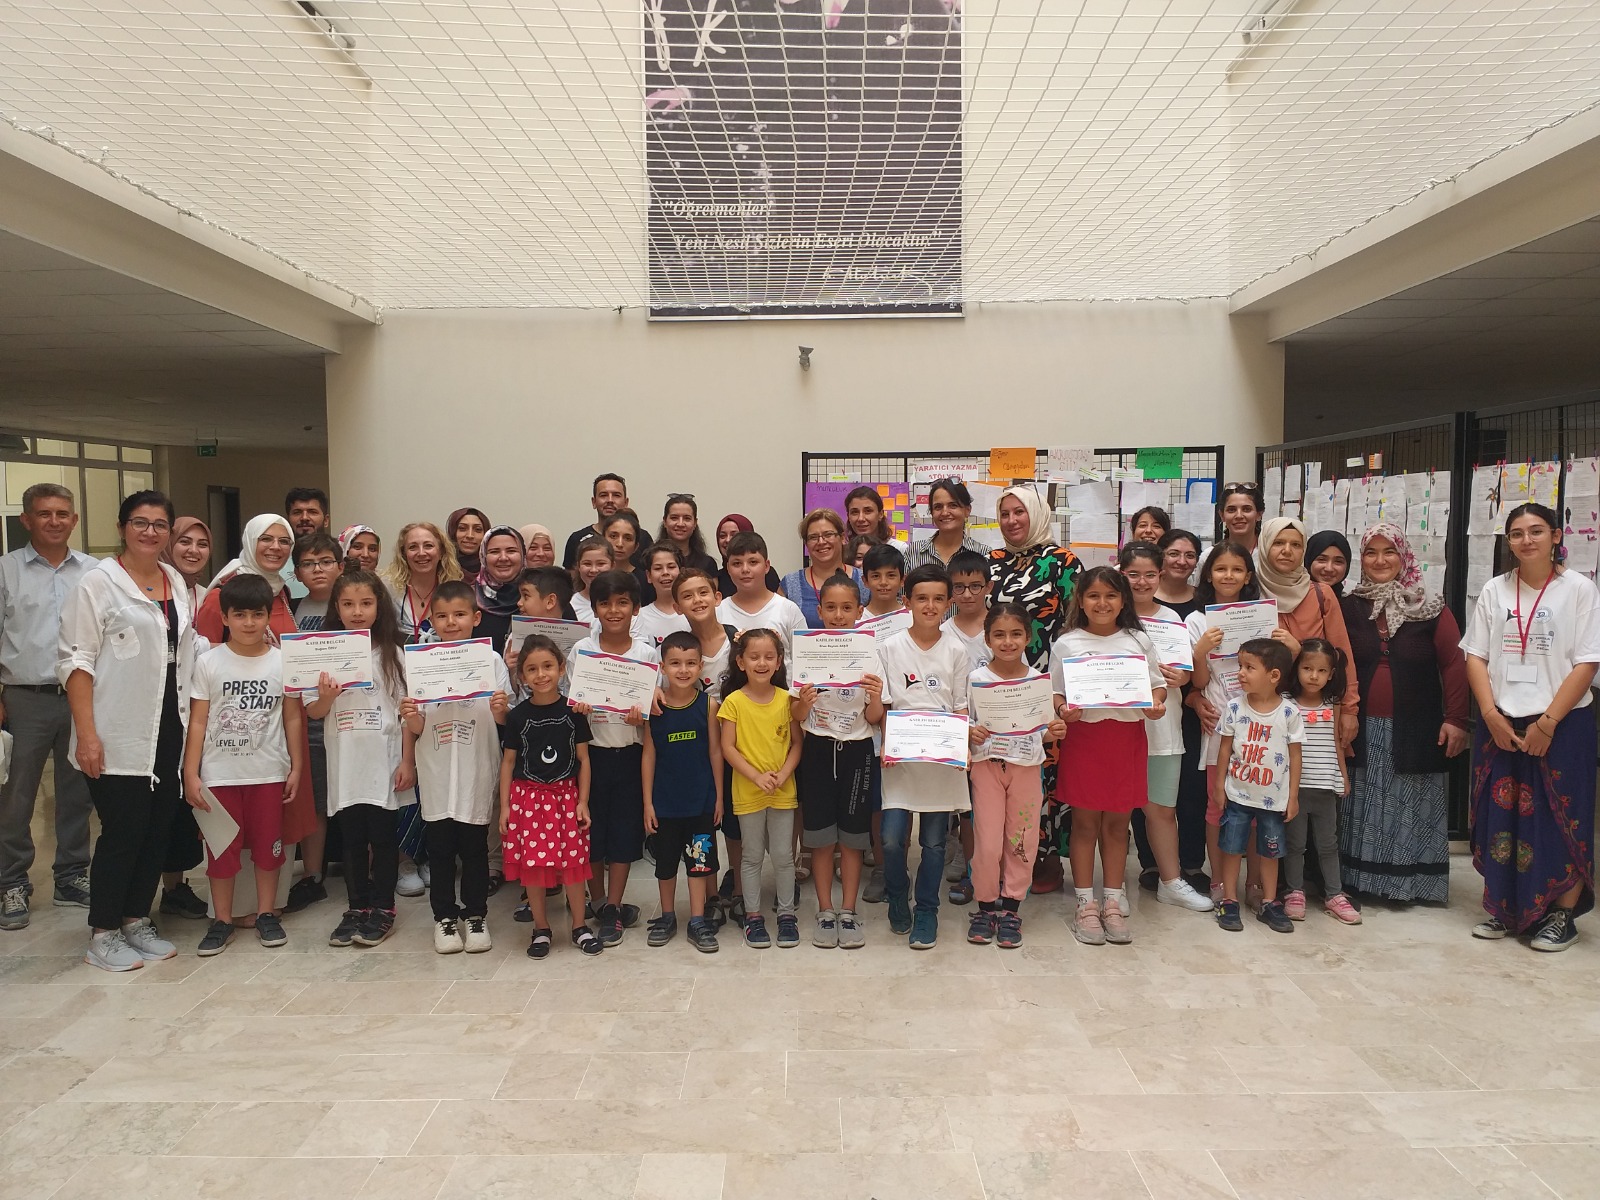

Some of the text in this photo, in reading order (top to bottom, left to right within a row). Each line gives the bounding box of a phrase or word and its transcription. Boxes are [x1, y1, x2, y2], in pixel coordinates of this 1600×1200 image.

[675, 234, 709, 250] Yeni
[713, 234, 751, 250] Nesil
[754, 233, 811, 249] Sizlerin
[815, 232, 854, 248] Eseri
[222, 680, 269, 697] PRESS
[239, 695, 281, 710] START
[669, 731, 695, 741] FASTER
[1247, 721, 1273, 743] HIT
[215, 738, 249, 747] LEVEL UP
[1241, 743, 1269, 766] THE
[1230, 760, 1274, 787] ROAD
